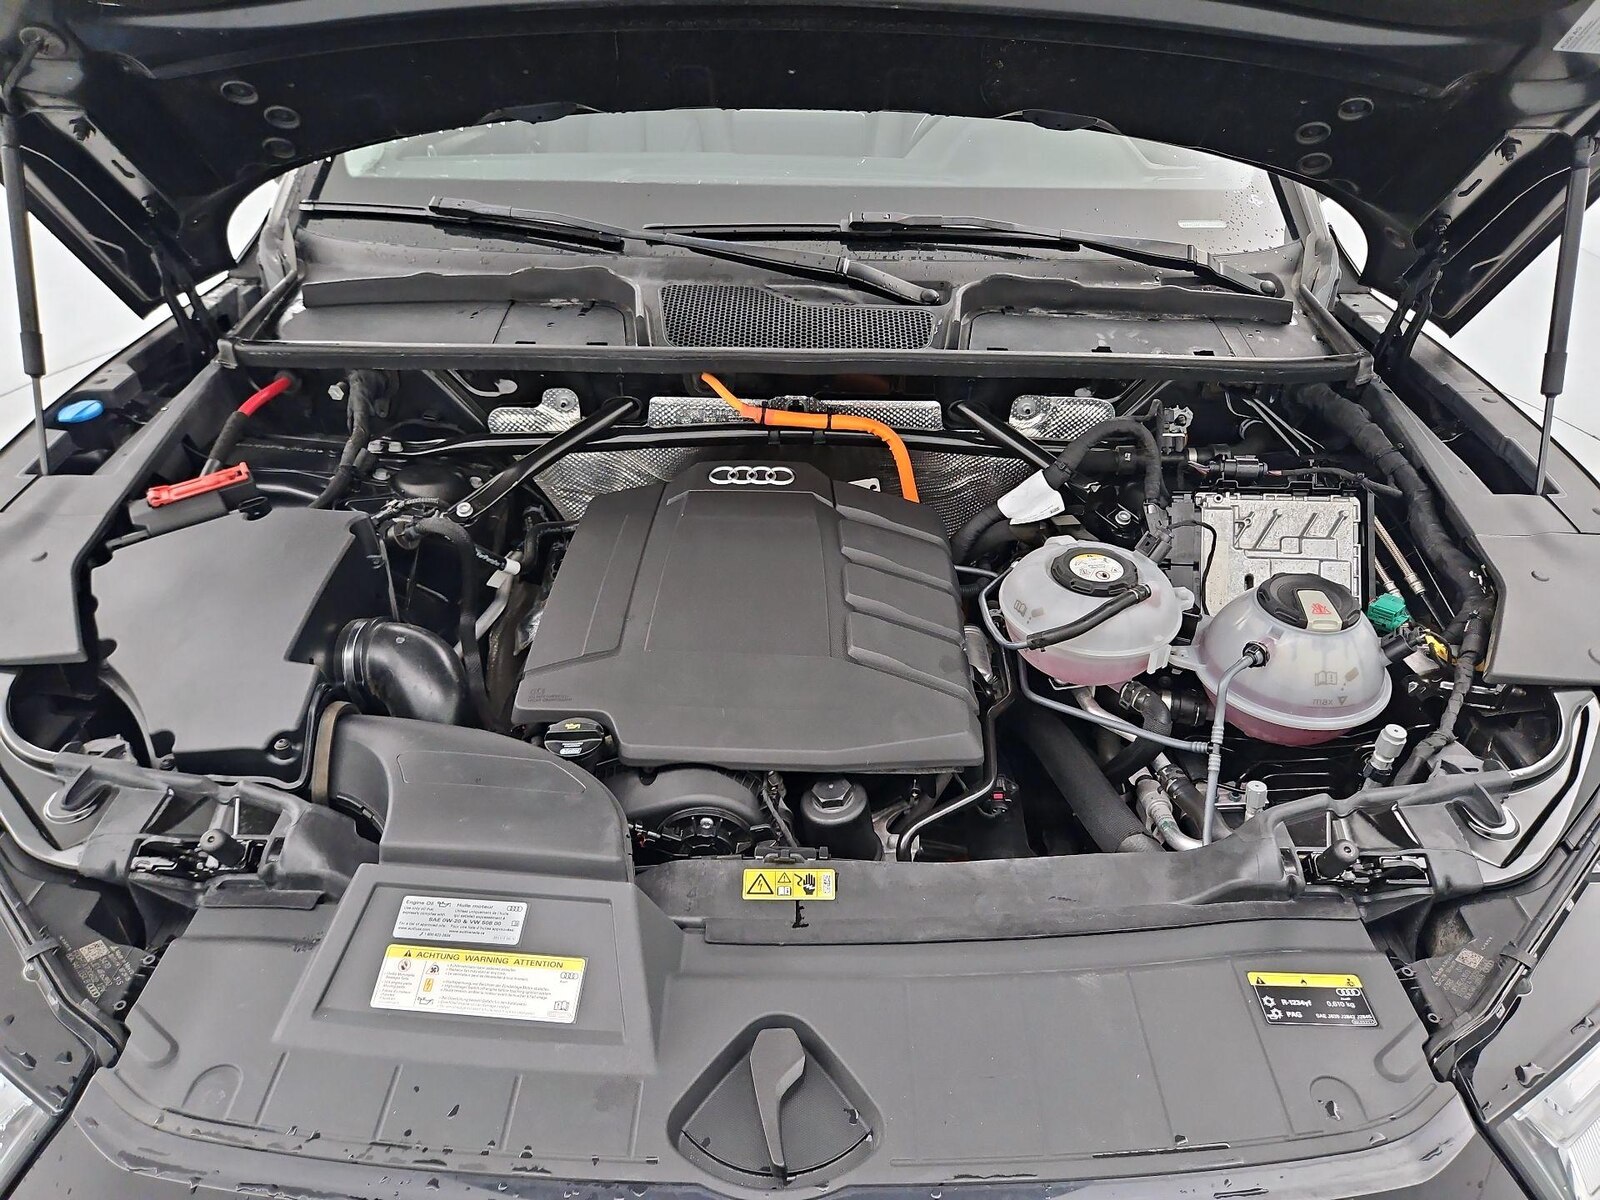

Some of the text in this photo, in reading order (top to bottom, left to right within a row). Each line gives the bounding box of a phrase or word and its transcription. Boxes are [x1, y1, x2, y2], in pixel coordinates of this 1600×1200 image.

[416, 951, 564, 968] ACHTUNG WARNING ATTENTION
[1281, 998, 1312, 1008] R-1234yf
[1345, 1001, 1356, 1009] kg
[1286, 1010, 1303, 1018] PAG
